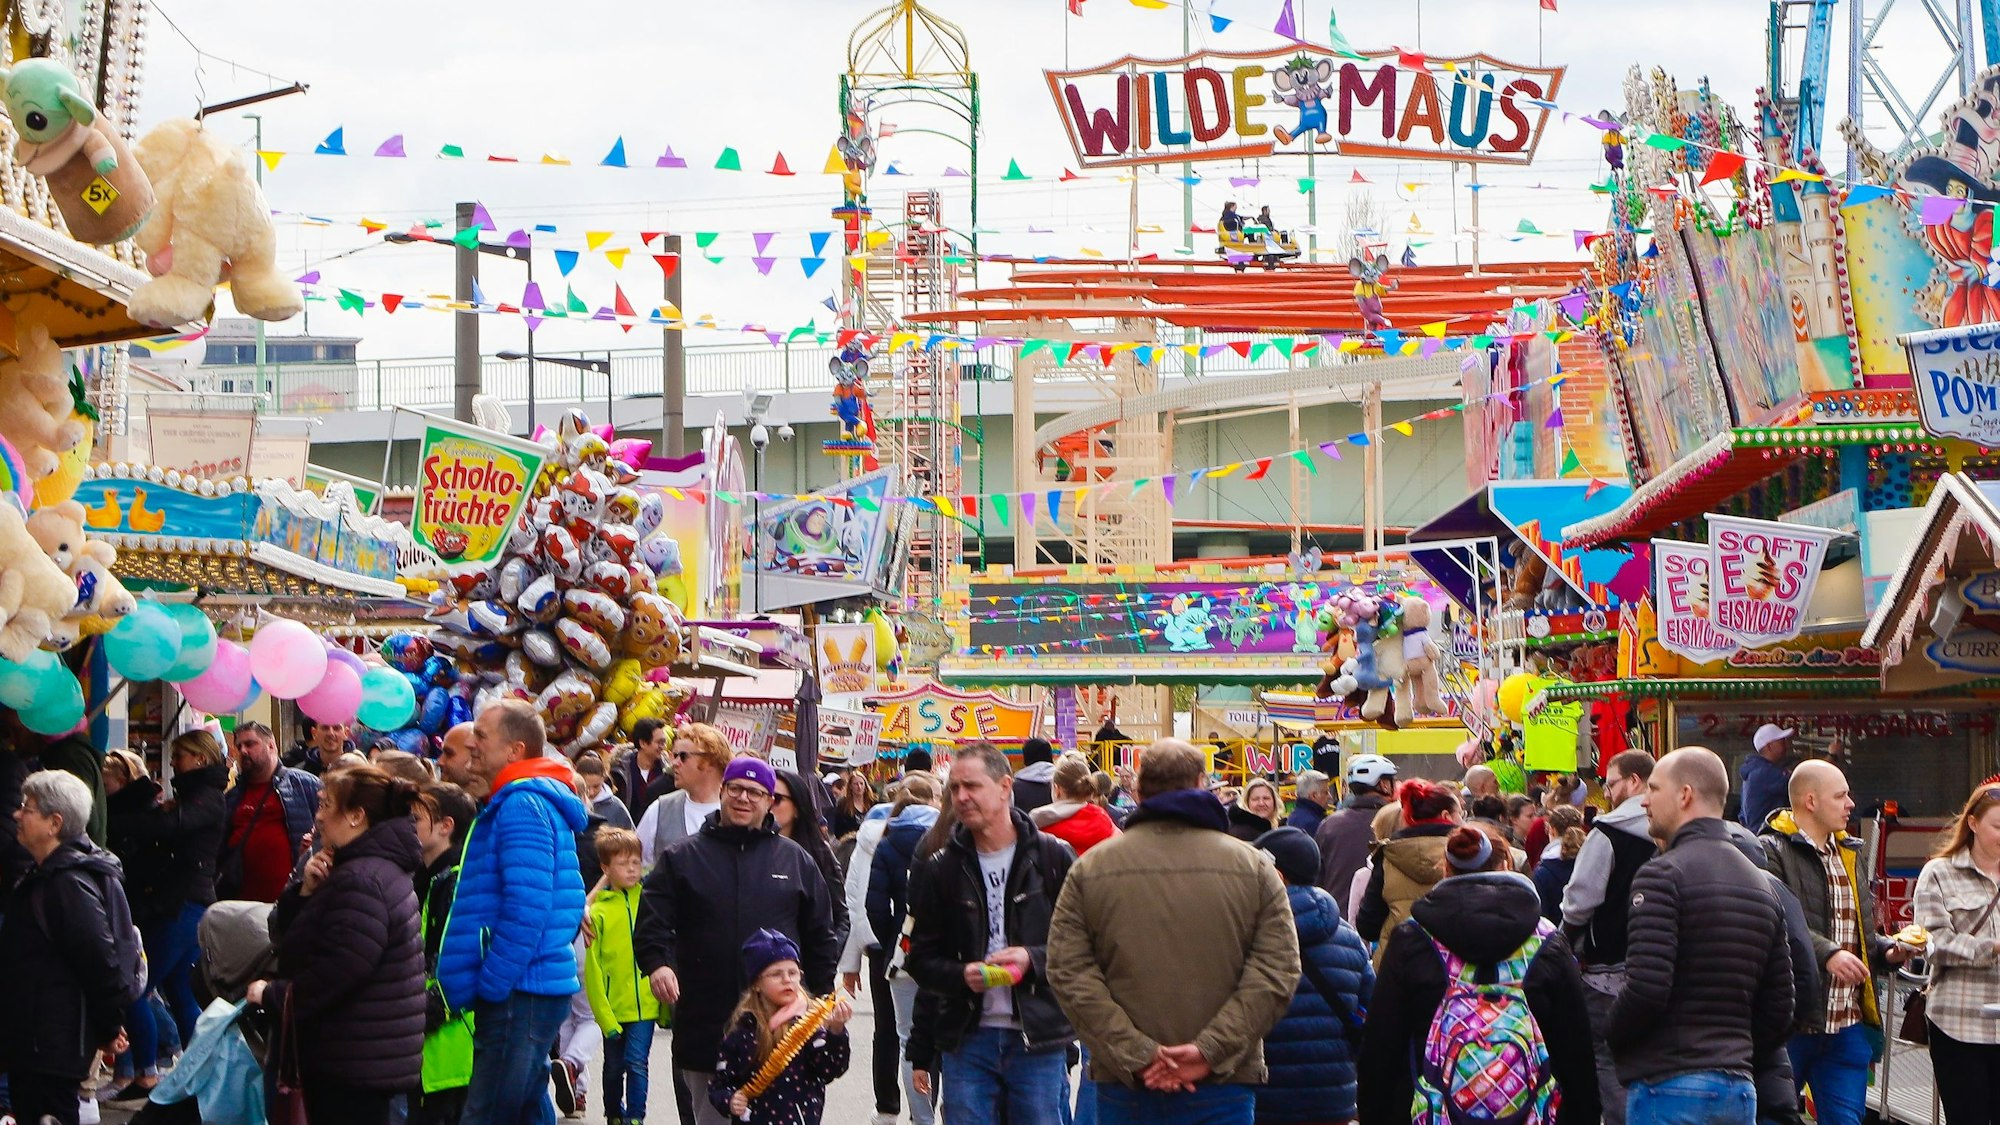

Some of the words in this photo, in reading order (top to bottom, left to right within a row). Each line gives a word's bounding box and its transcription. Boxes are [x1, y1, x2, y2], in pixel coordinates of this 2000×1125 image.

[1065, 64, 1268, 156] WILDE
[1338, 63, 1544, 152] MAUS
[1929, 370, 2000, 418] POM
[423, 456, 523, 496] Schoko-
[424, 492, 511, 527] früchte
[1718, 531, 1817, 562] SOFT
[1664, 554, 1710, 576] SO
[1717, 599, 1800, 634] EISMOHR
[1942, 639, 2000, 658] CURR
[884, 699, 1000, 736] ASSE
[1245, 743, 1314, 776] WIR
